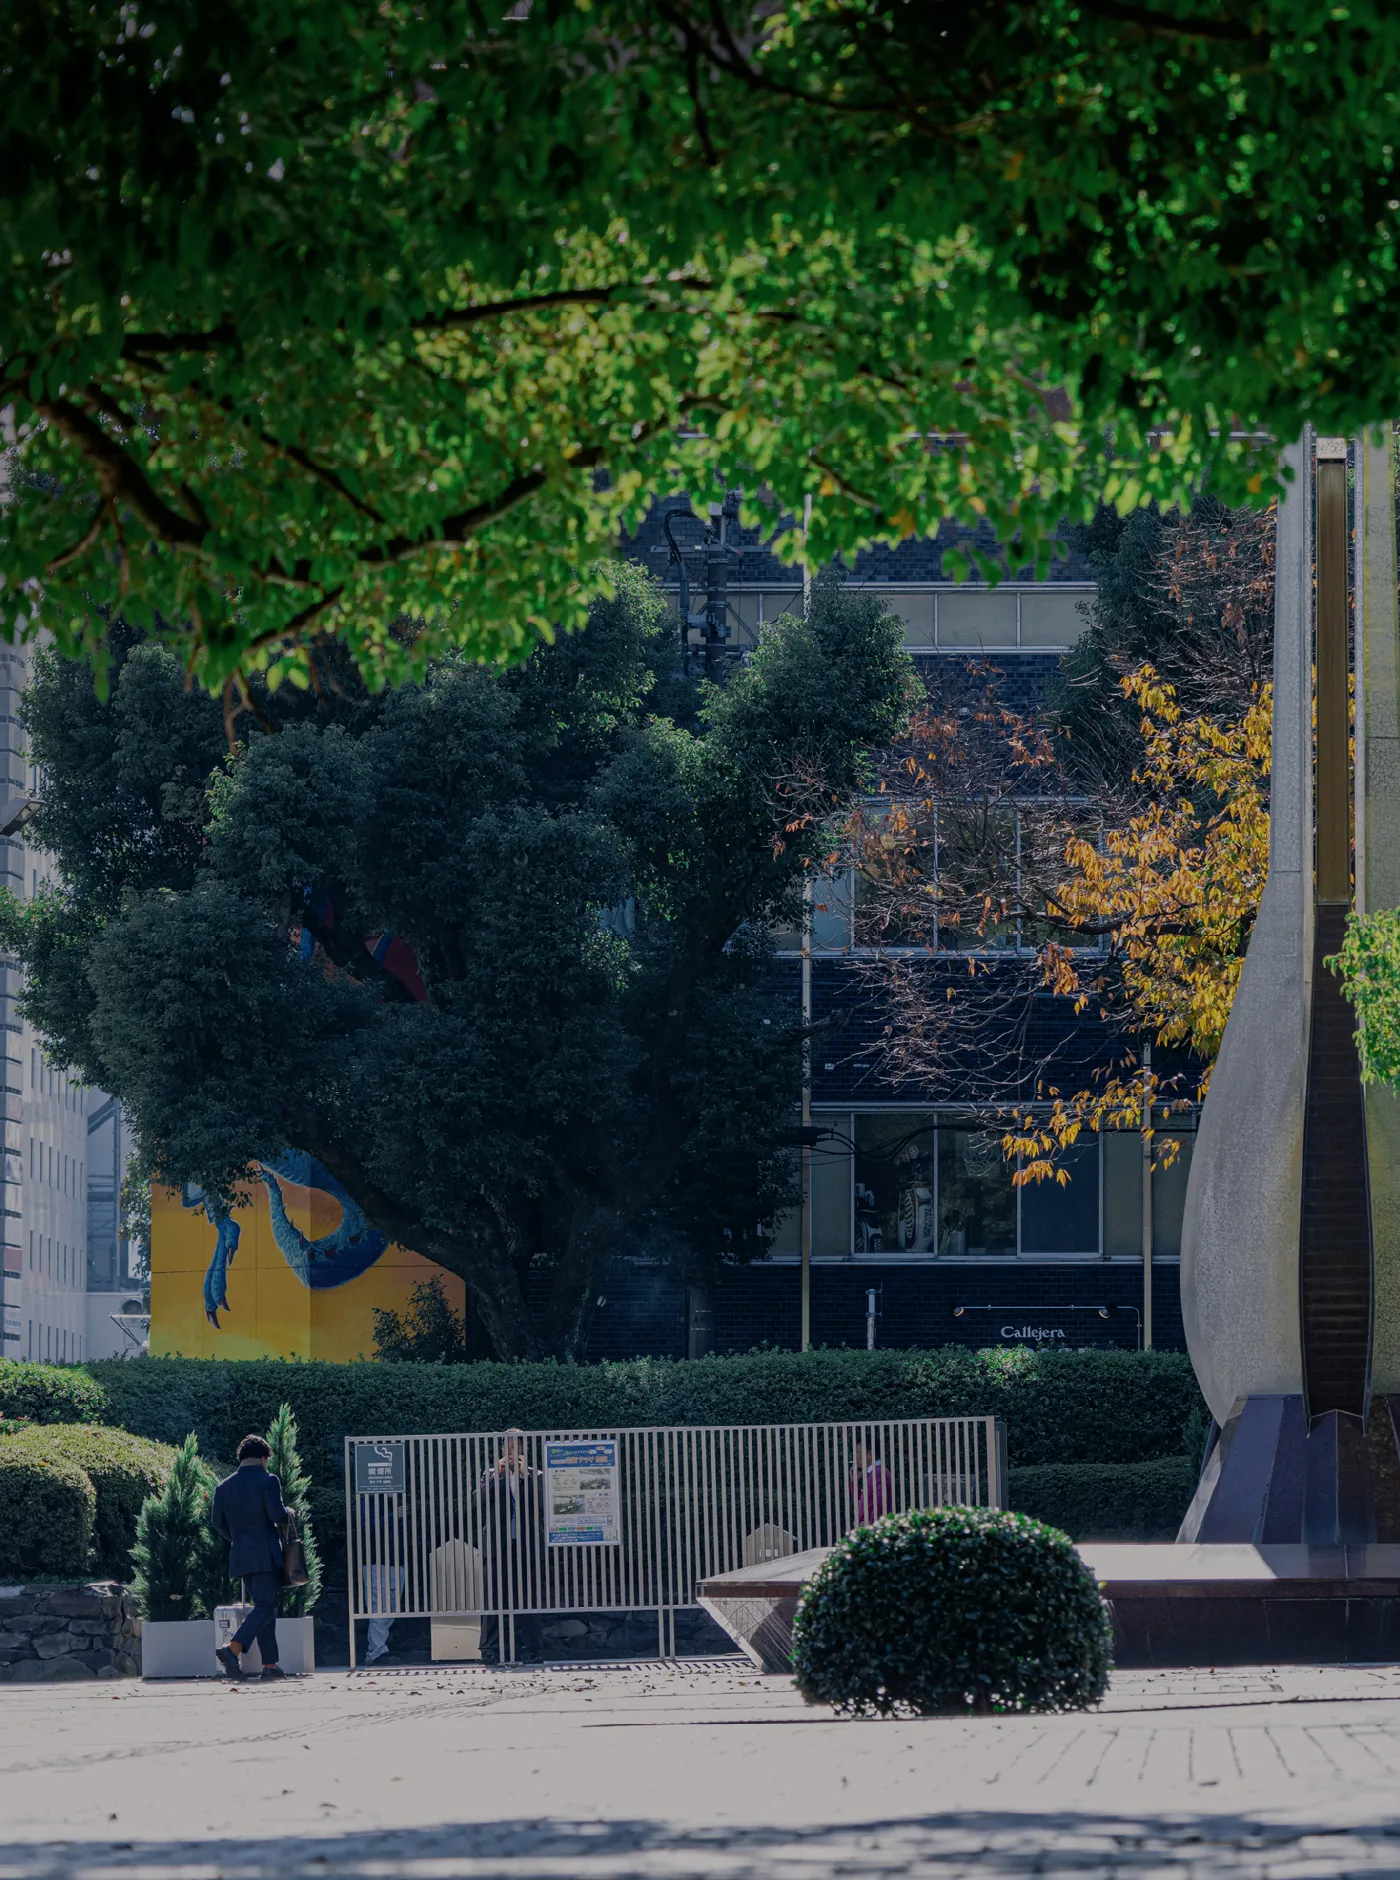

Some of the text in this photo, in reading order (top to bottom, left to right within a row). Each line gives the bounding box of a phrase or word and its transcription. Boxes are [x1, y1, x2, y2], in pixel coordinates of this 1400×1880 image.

[1000, 1325, 1066, 1341] Callejera
[368, 1467, 392, 1476] 喫煙所
